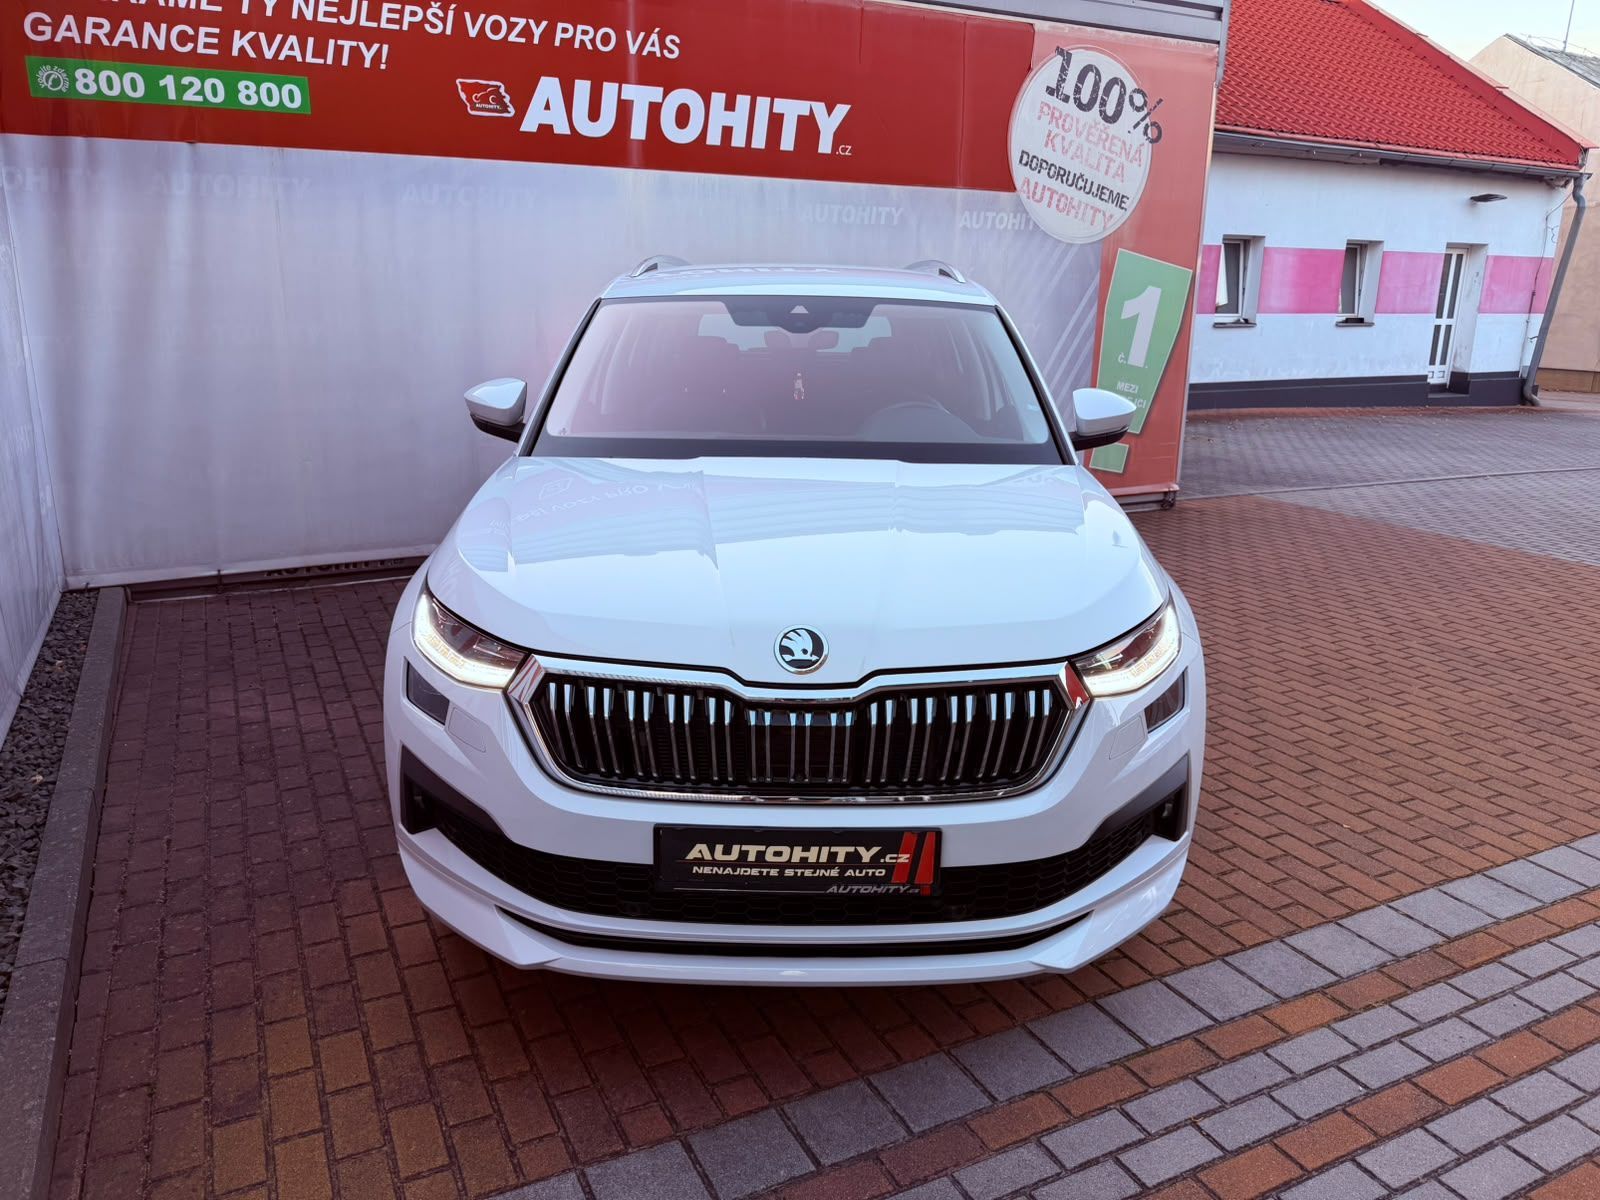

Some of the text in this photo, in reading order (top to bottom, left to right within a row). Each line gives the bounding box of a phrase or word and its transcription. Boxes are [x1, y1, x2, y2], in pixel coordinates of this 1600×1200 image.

[23, 11, 389, 70] GARANCE KVALITY!
[291, 0, 457, 36] NEJLEPŠÍ
[463, 11, 549, 45] VOZY
[554, 22, 617, 52] PRO
[625, 27, 681, 59] VÁS
[74, 68, 302, 109] 800 120 800
[1046, 46, 1163, 144] 100%
[1037, 101, 1145, 168] PROVĚŘENÁ
[1044, 130, 1125, 184] KVALITA
[1018, 150, 1130, 212] DOPORUČUJEME
[1019, 177, 1115, 229] AUTOHITY
[801, 203, 904, 226] AUTOHITY
[1116, 381, 1139, 394] MEZI
[692, 866, 887, 877] NENAJDETE STEJNÉ AUTO
